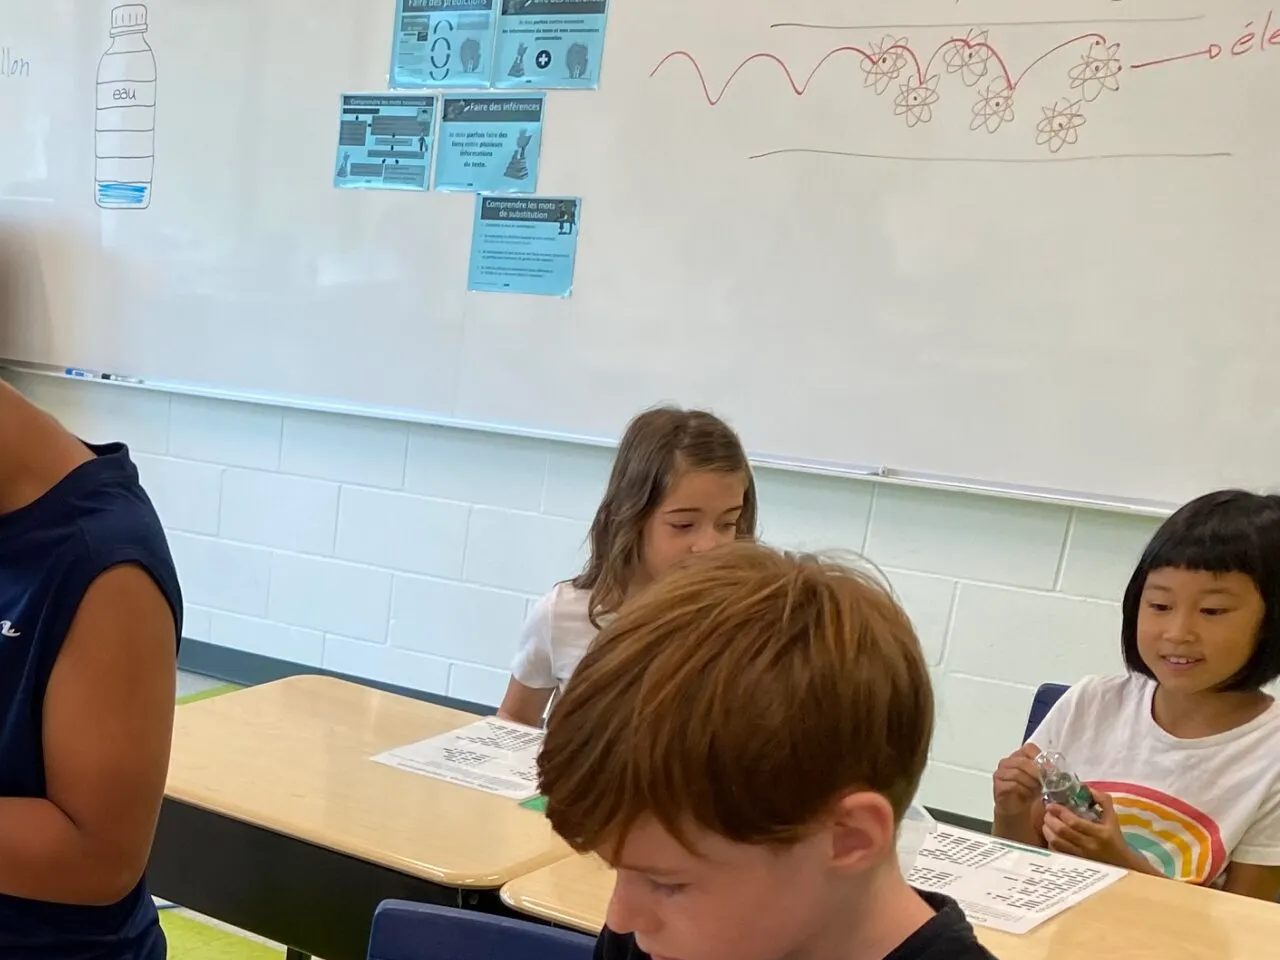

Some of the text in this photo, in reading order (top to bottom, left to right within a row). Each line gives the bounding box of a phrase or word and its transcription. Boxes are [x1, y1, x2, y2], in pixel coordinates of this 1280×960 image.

[113, 88, 136, 100] eau
[470, 101, 540, 111] Faire des inférences
[485, 200, 555, 210] Comprendre les mots
[499, 210, 548, 219] de substitution
